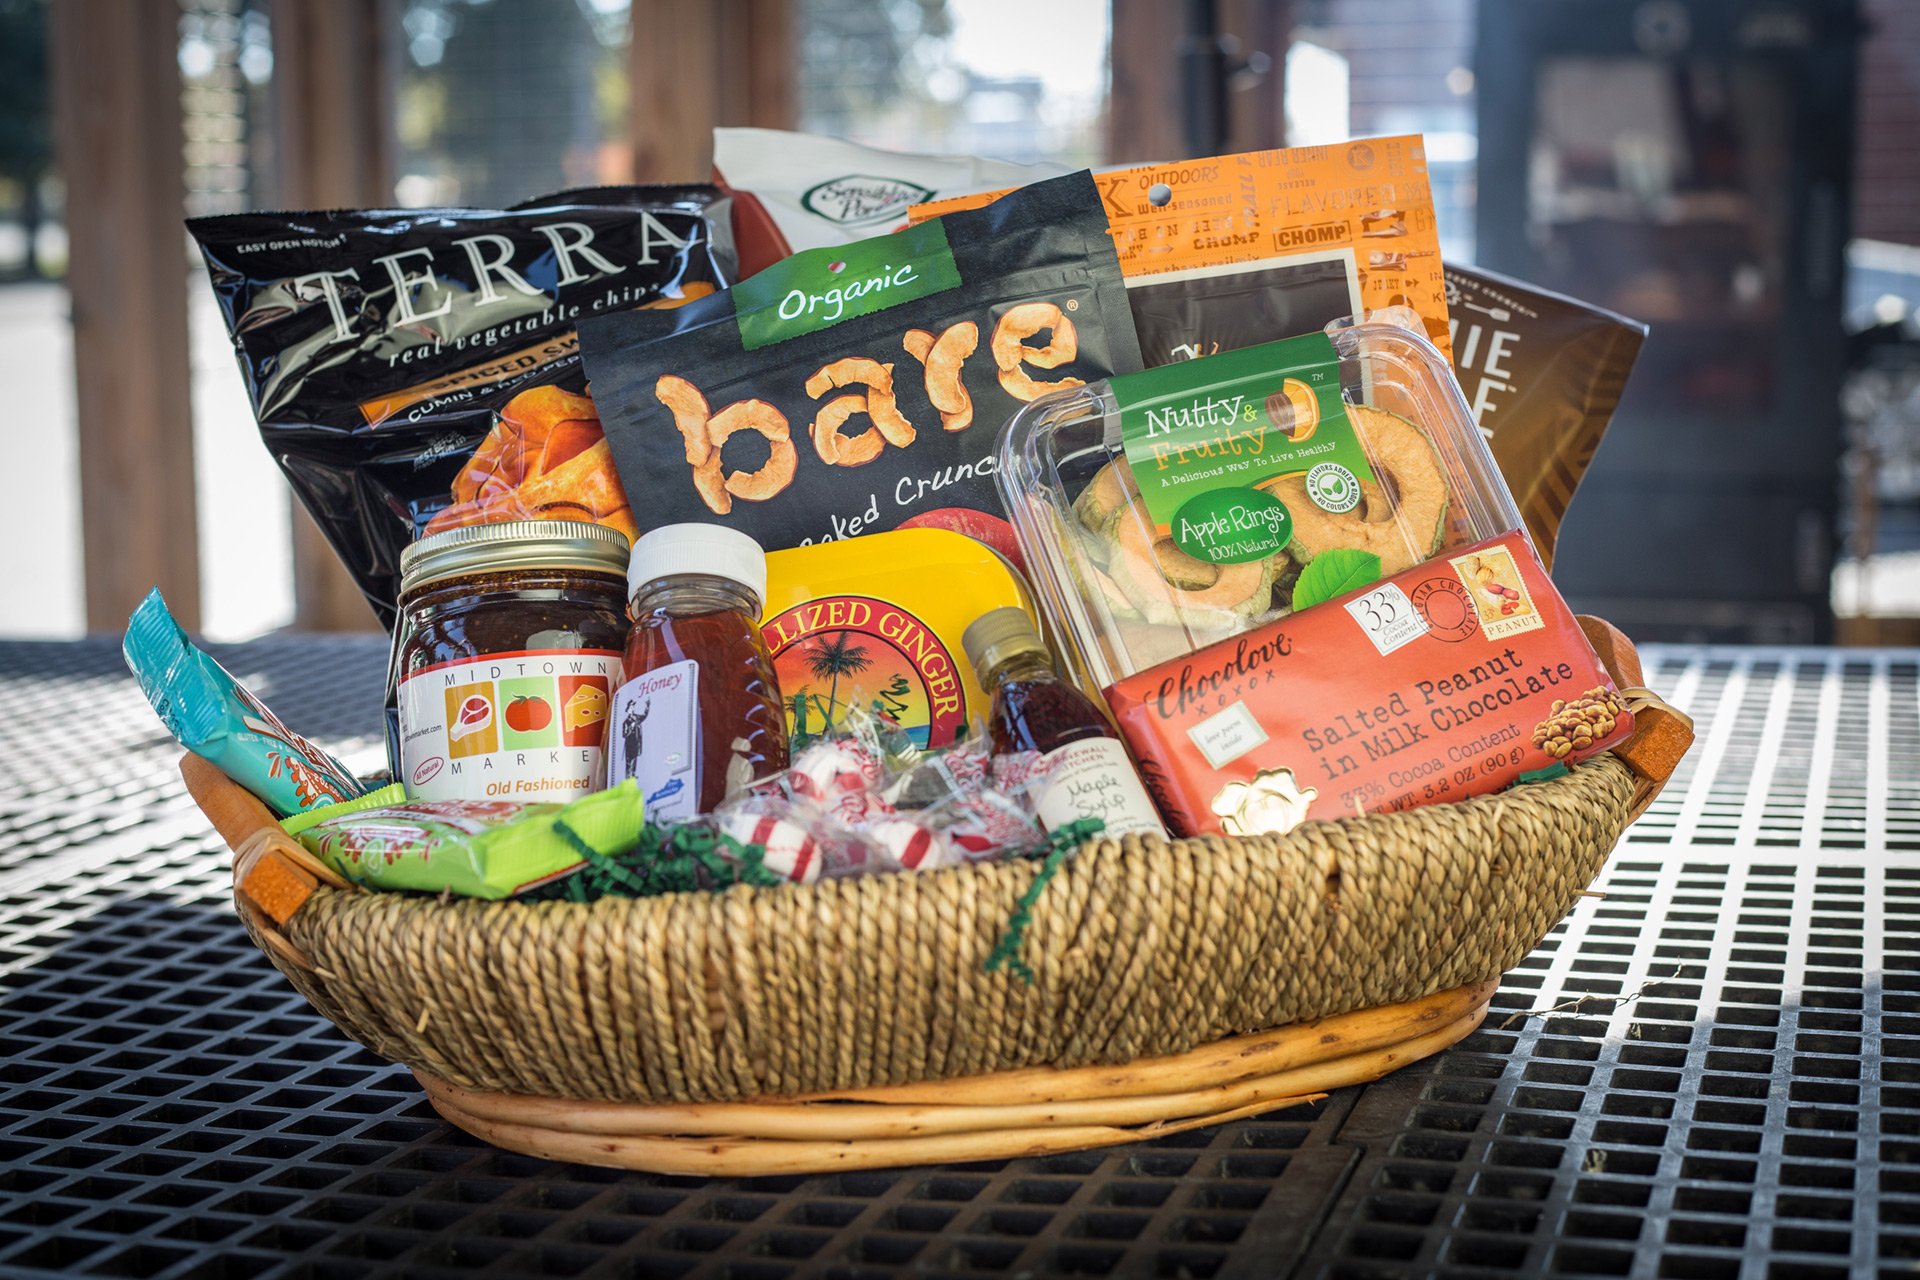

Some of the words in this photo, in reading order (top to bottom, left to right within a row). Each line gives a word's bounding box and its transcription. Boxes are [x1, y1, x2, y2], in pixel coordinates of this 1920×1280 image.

[237, 242, 266, 254] EASY
[269, 240, 300, 250] OPEN
[1193, 231, 1260, 250] CHOMP
[1279, 225, 1346, 247] CHOMP
[295, 212, 706, 345] TERRA
[778, 264, 919, 321] Organic
[388, 338, 443, 367] real
[456, 303, 580, 346] vegetable
[592, 281, 660, 311] chips
[430, 355, 537, 390] SPICED
[408, 391, 474, 423] CUMIN
[480, 385, 495, 395] &
[655, 302, 1088, 516] bare
[1144, 395, 1245, 439] Nutty
[1243, 404, 1258, 422] &
[1149, 425, 1268, 471] Fruity
[1161, 478, 1170, 487] A
[1172, 466, 1224, 485] Delicious
[1226, 460, 1250, 473] Way
[1253, 458, 1267, 467] To
[1271, 452, 1294, 464] Live
[1297, 442, 1337, 458] Healthy
[1334, 465, 1353, 482] ADDED
[800, 494, 880, 547] ked
[1325, 501, 1350, 511] COLORS
[1180, 512, 1231, 548] Apple
[1228, 505, 1285, 534] Rings
[1207, 543, 1239, 561] 100%
[1236, 534, 1280, 555] Natural
[1359, 588, 1401, 632] 33%
[1383, 619, 1409, 637] Cocoa
[1487, 614, 1539, 636] PEANUT
[1383, 622, 1418, 647] Content
[444, 662, 607, 686] MIDTOWN
[878, 611, 961, 719] GINGER
[1144, 633, 1293, 720] Chocolove
[637, 673, 683, 699] Honey
[1302, 693, 1410, 753] Salted
[1415, 648, 1523, 706] Peanut
[1320, 755, 1359, 781] in
[1361, 721, 1429, 763] Milk
[1430, 661, 1574, 733] Chocolate
[422, 760, 440, 775] Natural
[1388, 757, 1446, 788] Cocoa
[1447, 722, 1522, 763] Content
[486, 781, 511, 797] Old
[515, 776, 590, 793] Fashioned
[1066, 773, 1122, 806] Maple
[1392, 790, 1420, 812] WT.
[1424, 779, 1450, 800] 3.2
[1453, 766, 1476, 786] OZ
[1480, 753, 1507, 776] (90
[1510, 746, 1526, 765] g)
